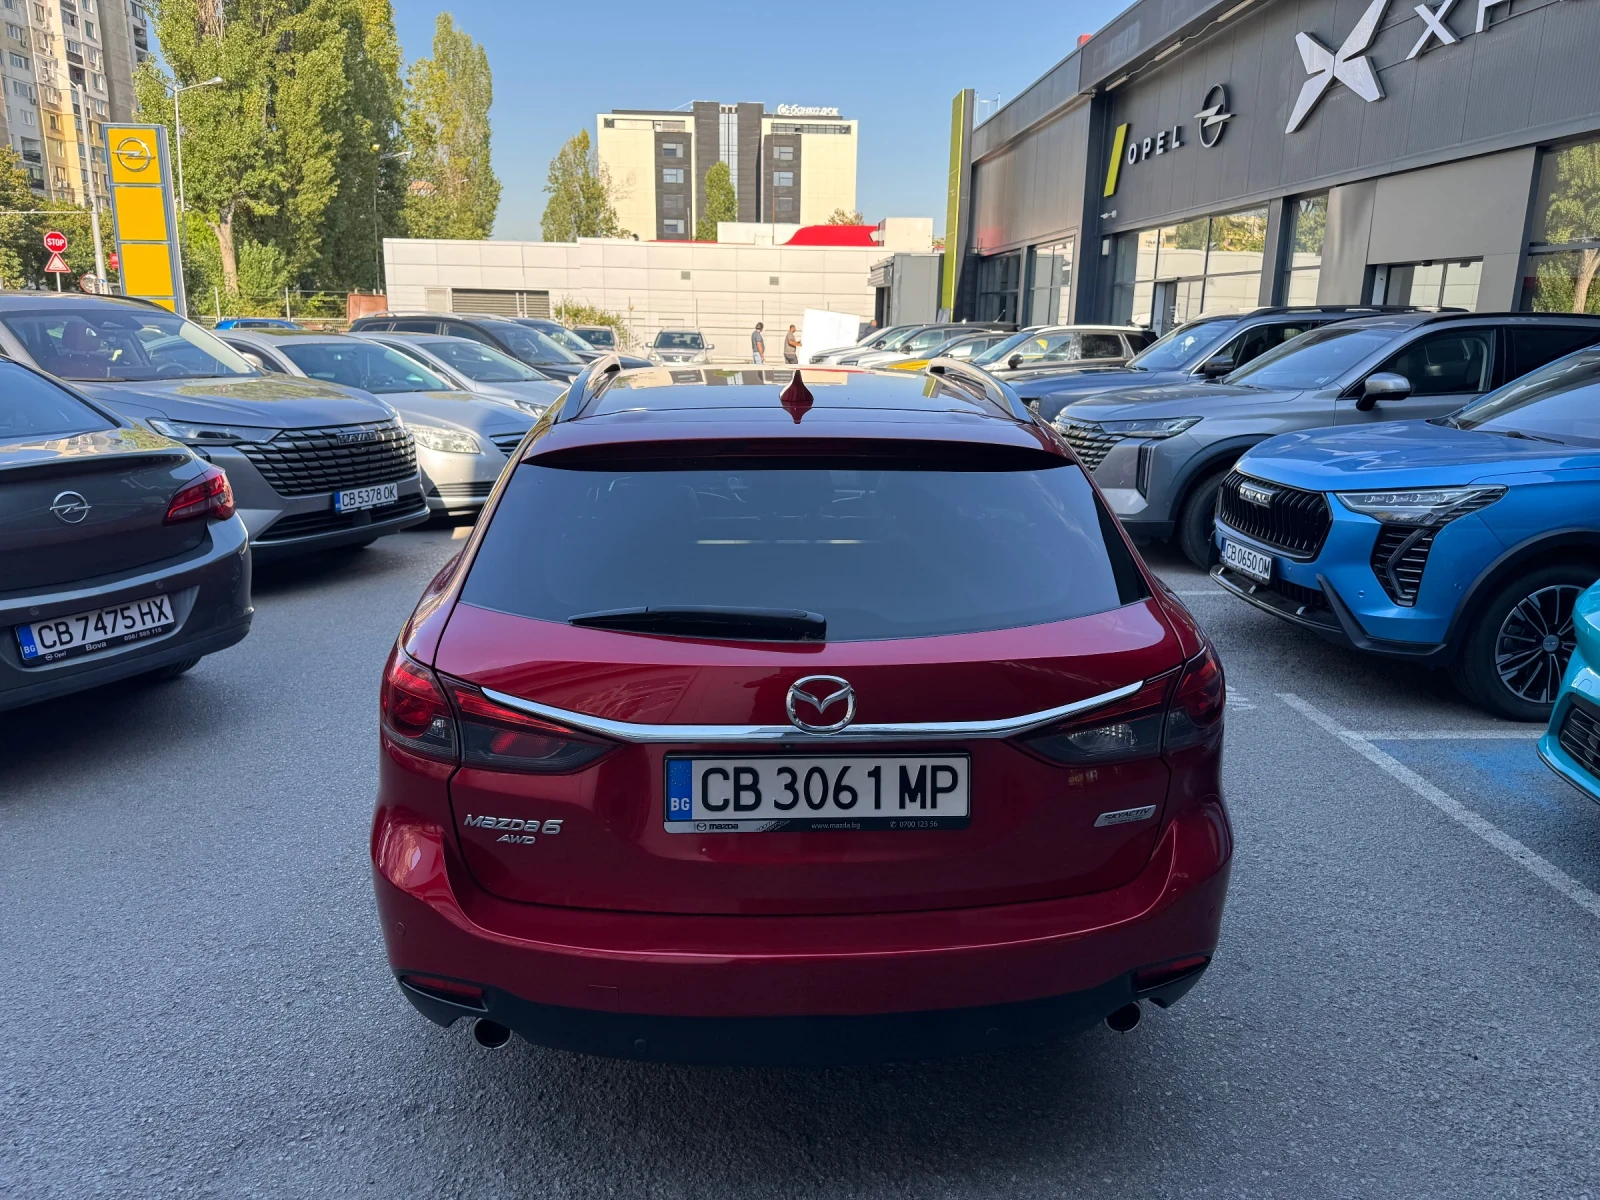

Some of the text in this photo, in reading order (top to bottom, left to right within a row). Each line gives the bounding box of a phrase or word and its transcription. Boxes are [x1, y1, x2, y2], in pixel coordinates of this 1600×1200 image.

[1128, 125, 1182, 165] OPEL
[46, 238, 65, 246] STOP
[342, 485, 396, 507] CB 5378 OK
[1226, 543, 1236, 561] CB
[1237, 548, 1257, 571] 0650
[1258, 557, 1271, 577] OM
[38, 598, 170, 650] CB 7475 HX
[24, 644, 36, 654] BG
[85, 641, 107, 652] Bova
[54, 651, 67, 659] Opel
[701, 764, 959, 812] CB 3061 MP
[670, 797, 690, 811] BG
[1104, 808, 1152, 819] SKYACTIV
[811, 822, 861, 830] www.mazda.bg
[917, 820, 929, 828] 123
[929, 820, 938, 828] 56
[496, 834, 536, 844] AWD
